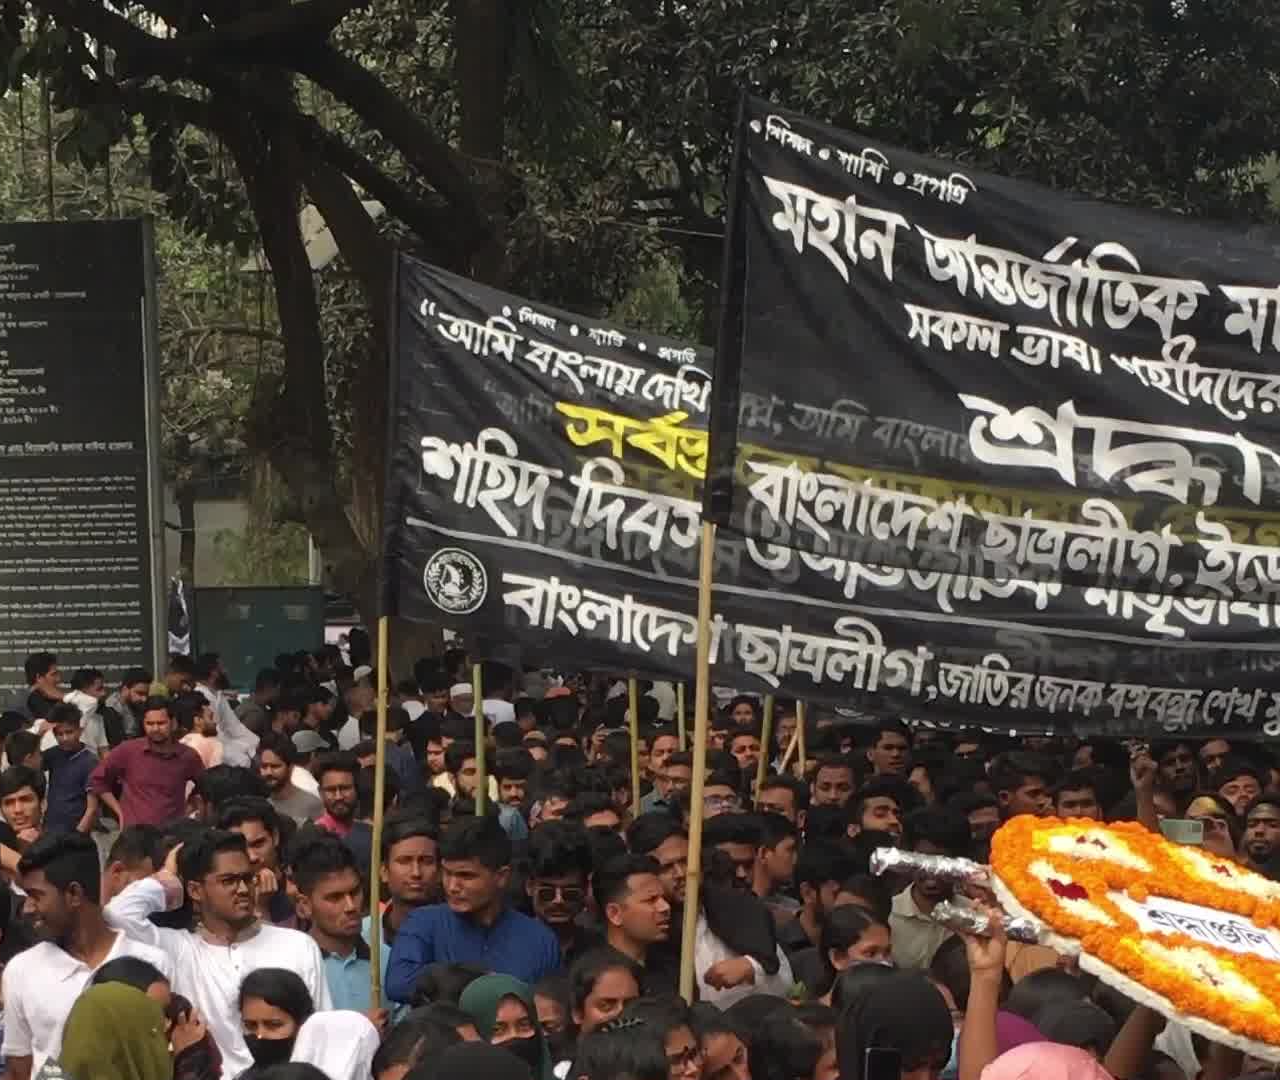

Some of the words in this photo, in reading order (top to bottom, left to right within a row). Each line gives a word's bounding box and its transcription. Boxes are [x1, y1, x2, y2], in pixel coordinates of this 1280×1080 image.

[763, 176, 911, 284] মহান
[914, 236, 1210, 341] আন্তর্জাতিক
[524, 338, 646, 396] বাংলায়
[904, 303, 1009, 360] সকল
[1011, 324, 1103, 376] ভাষা
[745, 460, 987, 554] বাংলাদেশ
[501, 571, 728, 665] বাংলাদেশ
[937, 652, 1036, 709] জাতির
[1034, 674, 1106, 716] জনক
[1201, 686, 1268, 725] শেখ
